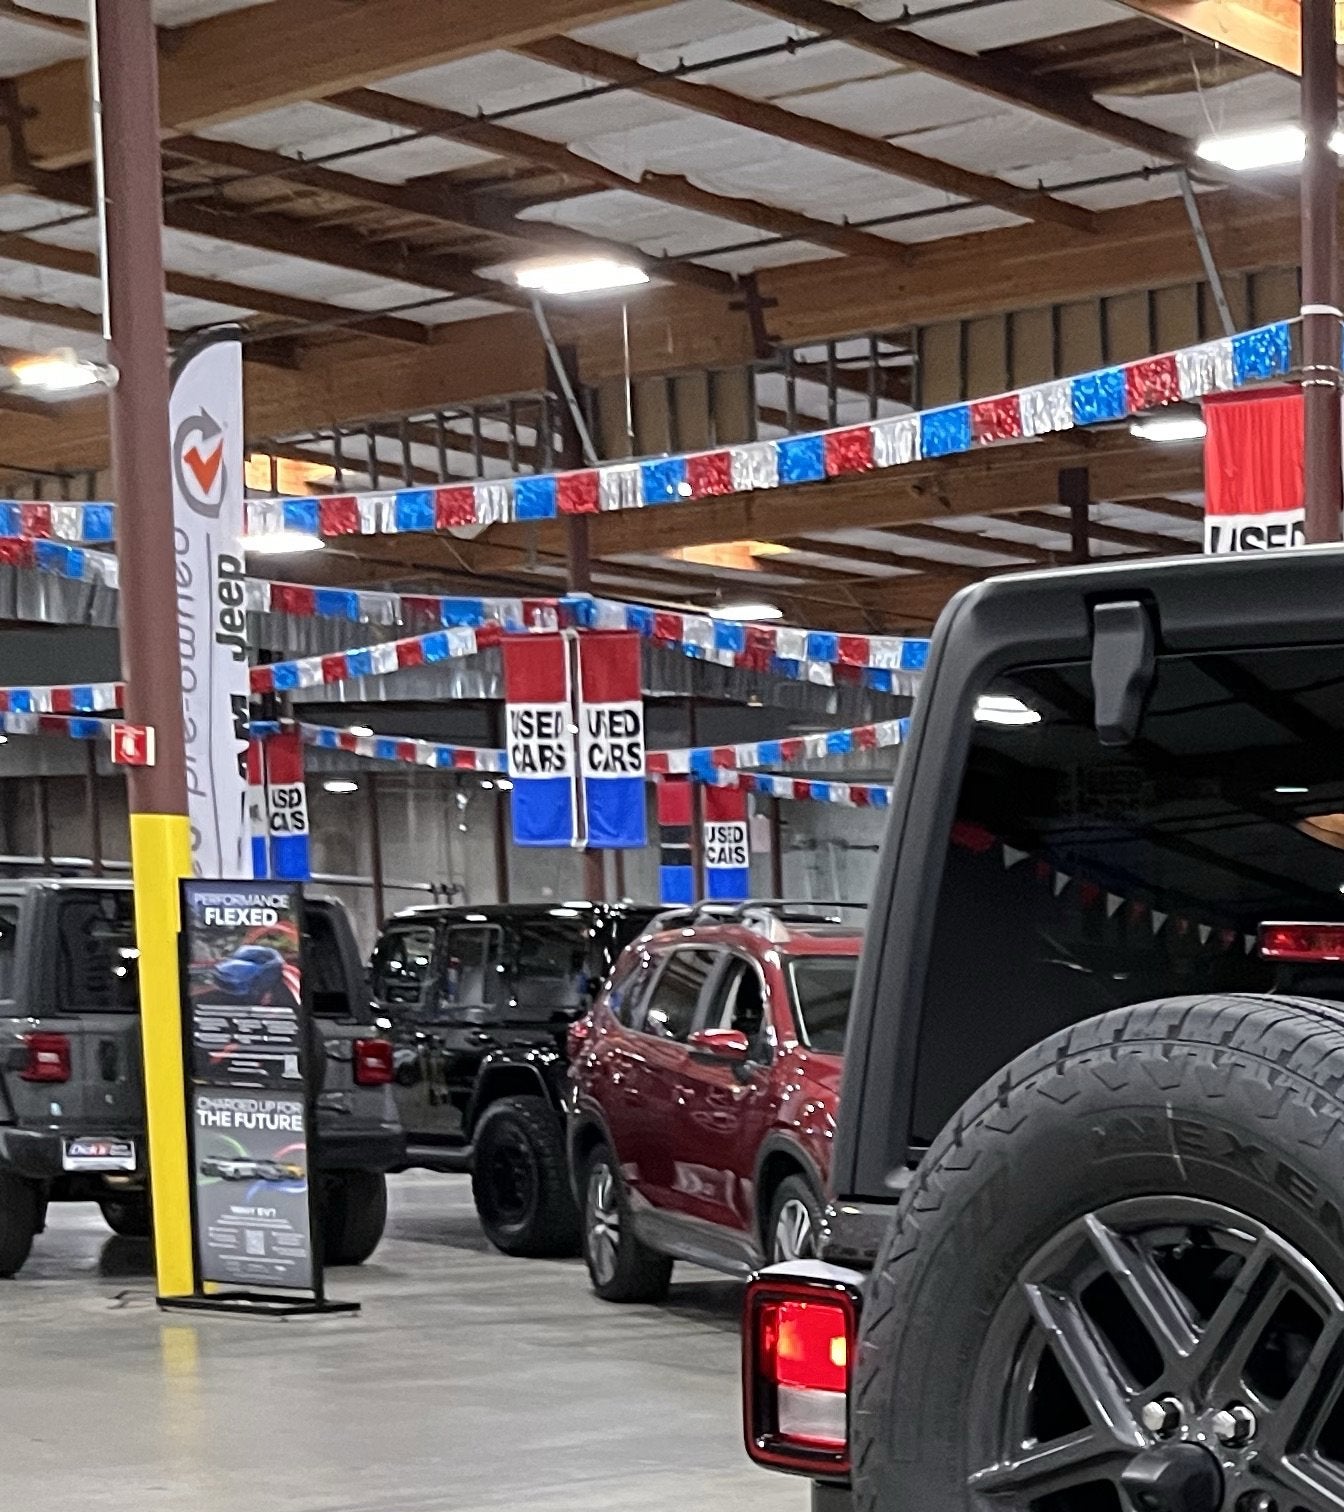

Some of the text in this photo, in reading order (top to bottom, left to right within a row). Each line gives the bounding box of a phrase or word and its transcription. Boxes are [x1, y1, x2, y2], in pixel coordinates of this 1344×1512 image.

[1210, 524, 1305, 554] USE
[216, 553, 246, 662] Jeep
[512, 743, 567, 773] CARS
[272, 788, 302, 808] USD
[270, 811, 306, 832] CAS
[204, 907, 279, 926] FLEXED
[259, 1100, 276, 1113] UP
[277, 1101, 304, 1114] FOR
[197, 1110, 305, 1131] THE FUTURE
